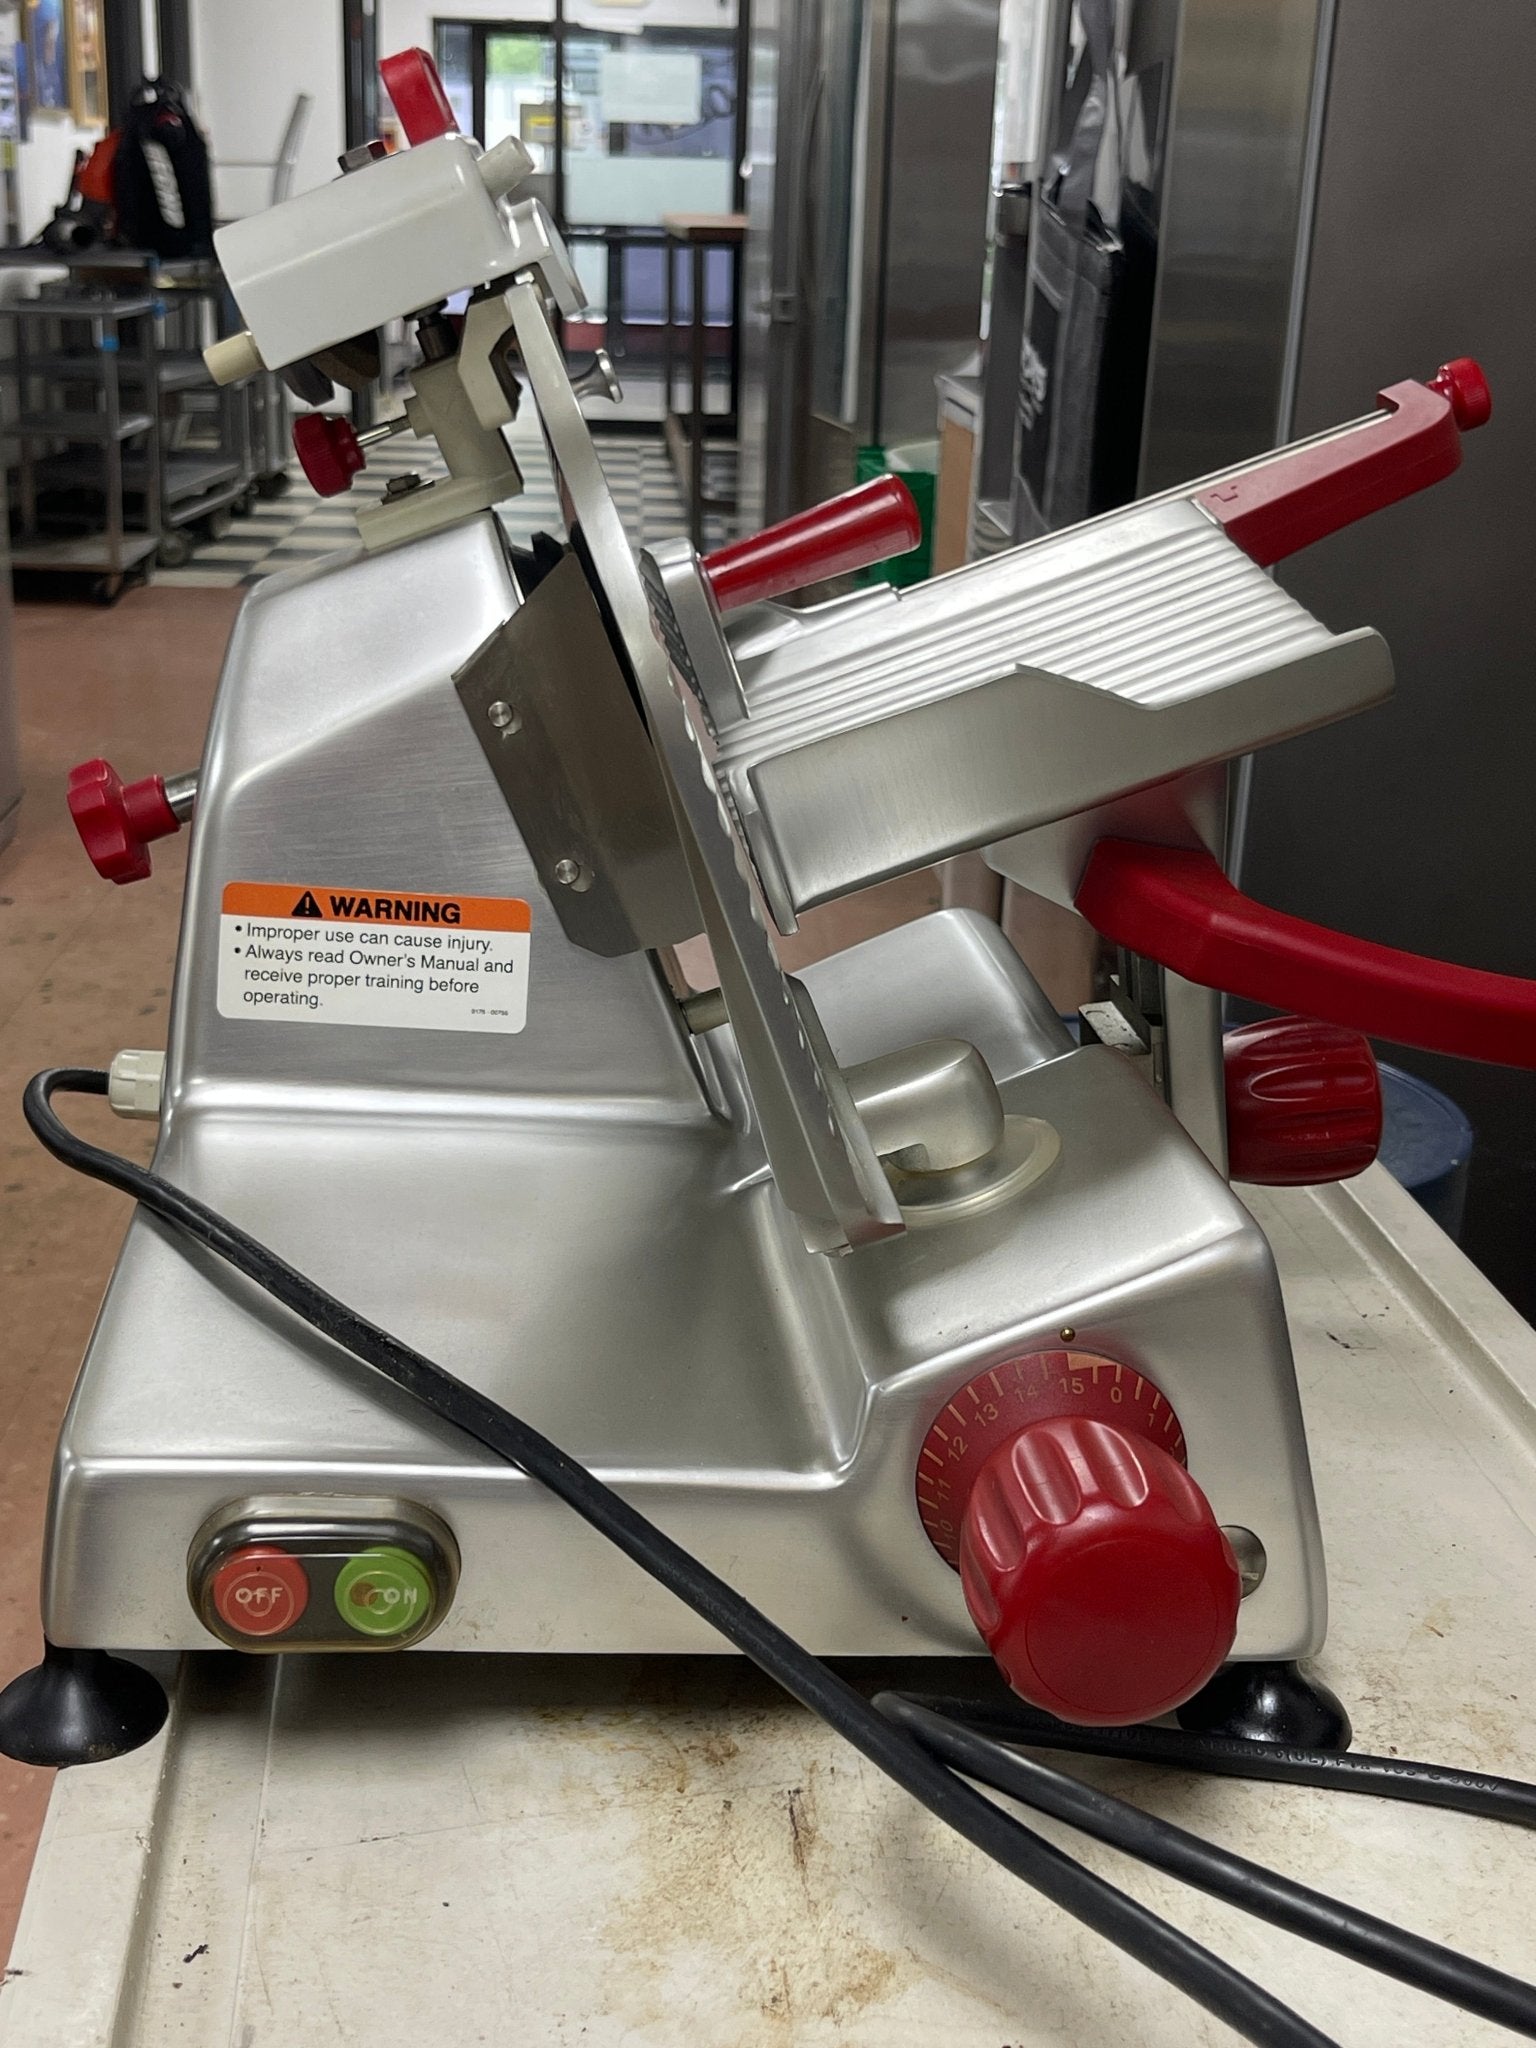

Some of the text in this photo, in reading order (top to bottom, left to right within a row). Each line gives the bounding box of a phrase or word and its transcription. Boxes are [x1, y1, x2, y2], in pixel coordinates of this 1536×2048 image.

[330, 896, 460, 924] WARNING
[247, 923, 492, 954] Improper use can cause injury.
[245, 945, 513, 973] Always read Owner's Manual and
[245, 969, 479, 993] receive proper training before
[244, 991, 322, 1009] operating.
[1014, 1383, 1038, 1403] 14
[1059, 1377, 1085, 1395] 15
[1110, 1386, 1123, 1403] 0
[974, 1402, 999, 1427] 13
[1147, 1412, 1155, 1428] 1
[947, 1435, 969, 1462] 12
[936, 1477, 952, 1502] 11
[939, 1518, 956, 1540] 10
[235, 1587, 283, 1605] OFF
[383, 1587, 417, 1605] ON
